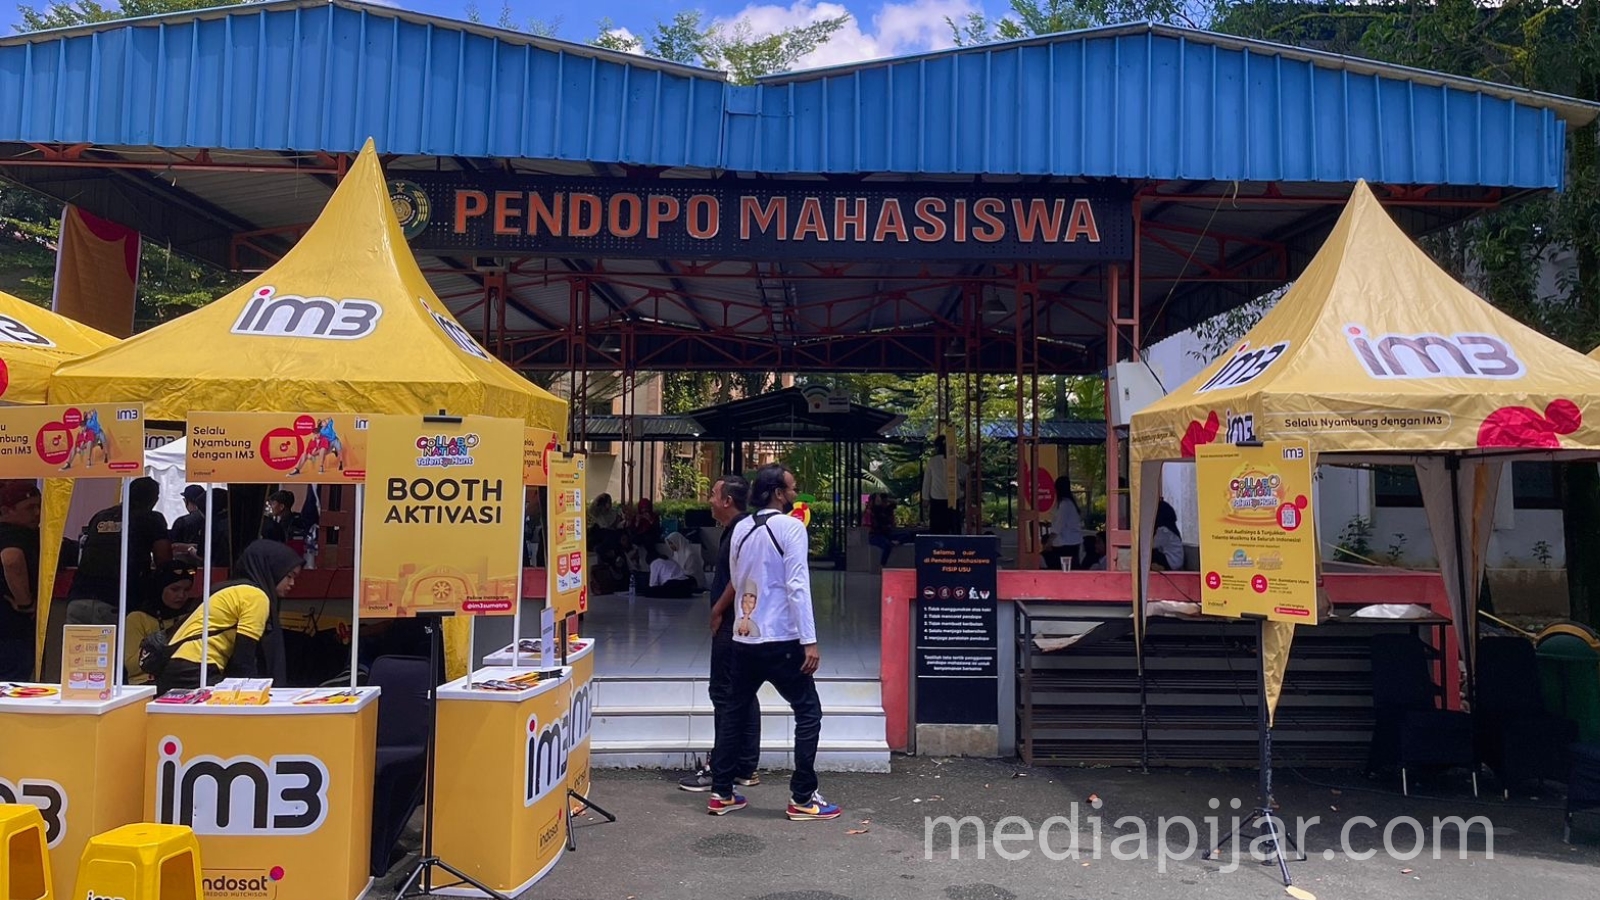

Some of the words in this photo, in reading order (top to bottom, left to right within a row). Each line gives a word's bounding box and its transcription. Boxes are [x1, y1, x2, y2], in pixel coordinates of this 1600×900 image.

[453, 188, 720, 240] PENDOPO
[739, 195, 1101, 242] MAHASISWA
[236, 288, 378, 337] im3
[1347, 326, 1520, 376] im3
[1198, 343, 1287, 392] im3
[117, 408, 138, 420] im3
[355, 416, 368, 429] im
[1284, 418, 1318, 427] Selalu
[1320, 417, 1378, 428] Nyambung
[1380, 416, 1421, 428] dengan
[1423, 416, 1442, 425] IM3
[193, 426, 226, 435] Selalu
[0, 434, 28, 445] mbung
[193, 438, 251, 450] Nyambung
[416, 433, 480, 449] COLLABO
[14, 446, 32, 455] IM3
[192, 450, 233, 460] dengan
[235, 450, 255, 459] IM3
[423, 445, 468, 457] NATION
[1283, 446, 1304, 459] im3
[417, 457, 443, 466] Talent
[451, 456, 473, 465] Hunt
[387, 477, 502, 501] BOOTH
[384, 505, 501, 524] AKTIVASI
[467, 602, 509, 610] @im3sumatra
[160, 741, 323, 829] im3
[202, 875, 268, 891] ndosat
